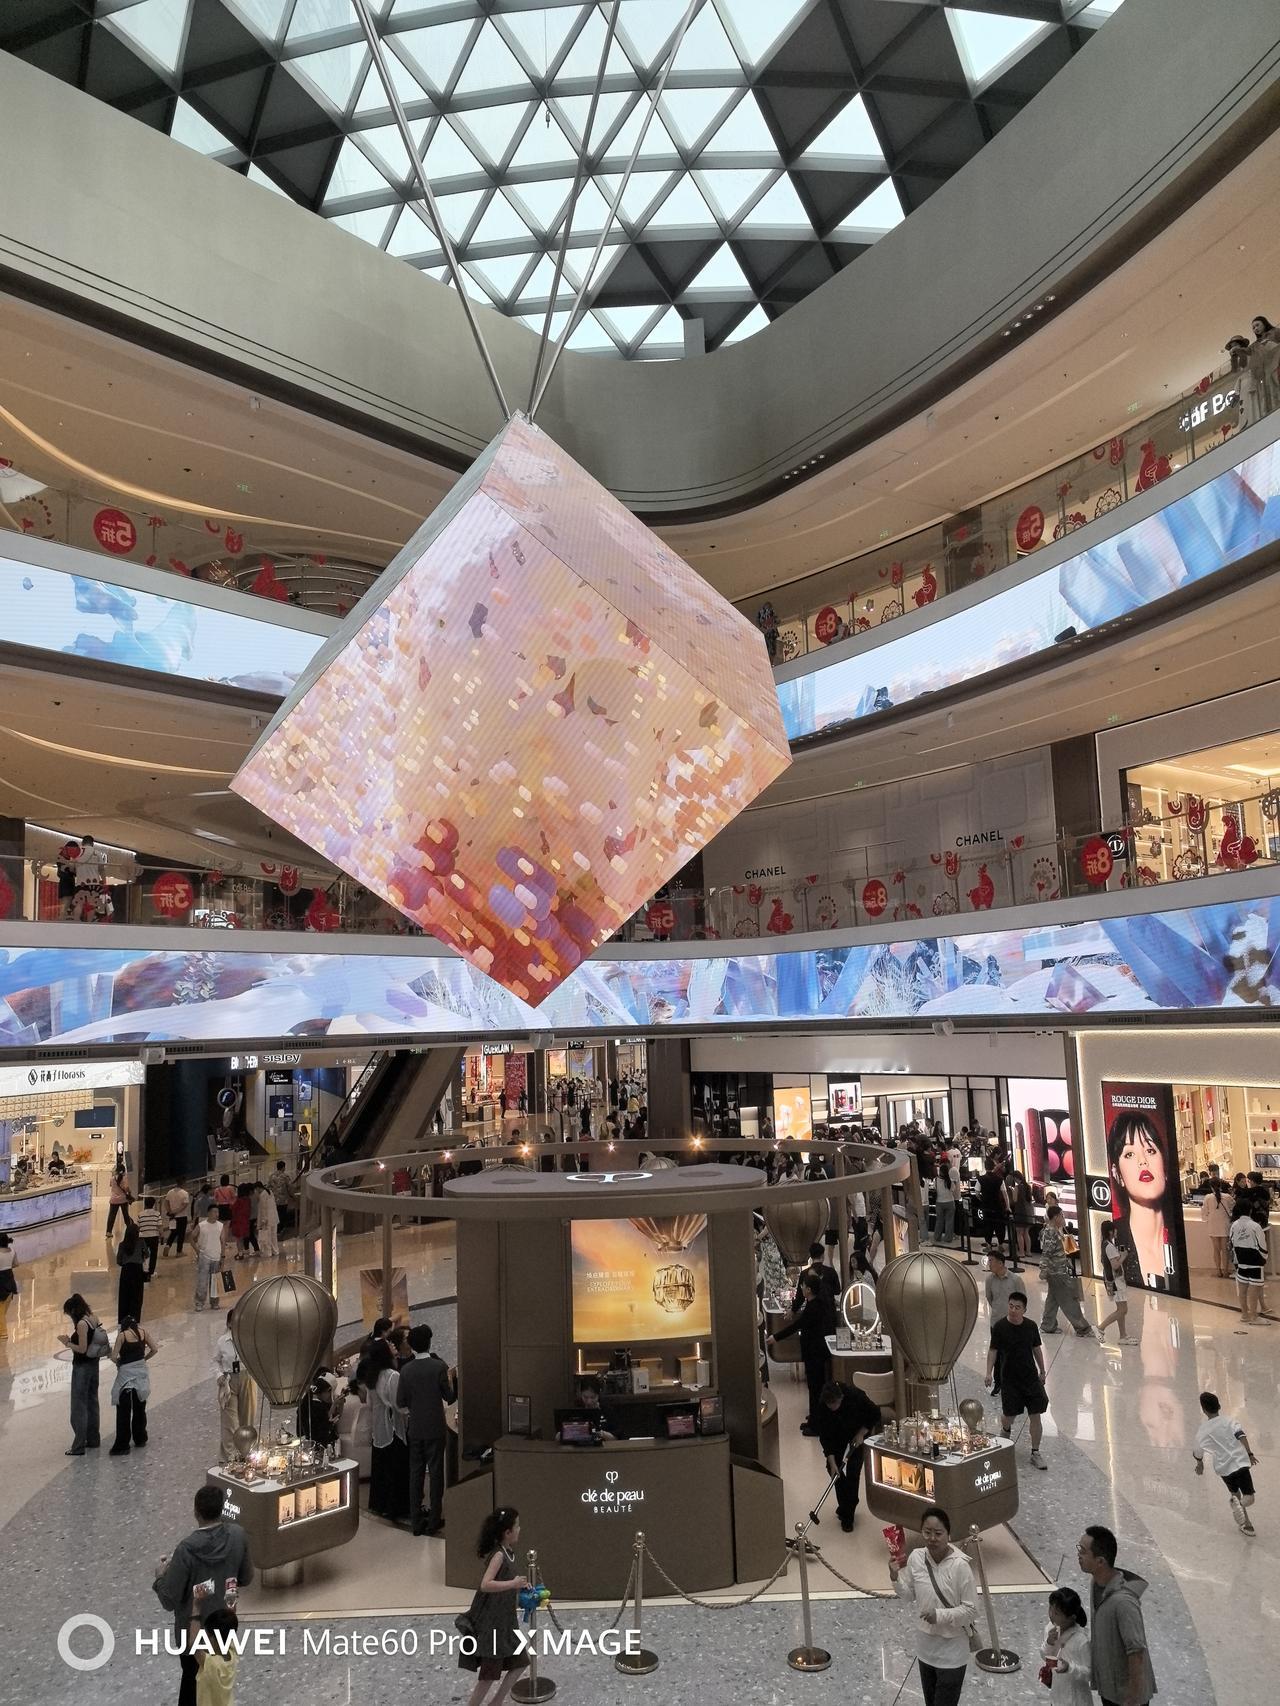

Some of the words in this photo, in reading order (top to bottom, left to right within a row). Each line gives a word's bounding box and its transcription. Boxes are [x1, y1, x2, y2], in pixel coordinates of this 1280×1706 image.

[956, 830, 1004, 847] CHANEL
[745, 866, 786, 879] CHANEL
[263, 1053, 302, 1065] sisley
[1111, 1095, 1136, 1103] ROUGE
[1137, 1096, 1156, 1105] DIOR
[581, 1488, 598, 1502] clé
[600, 1488, 615, 1502] de
[616, 1490, 644, 1505] peau
[593, 1504, 633, 1514] BEAUTÉ
